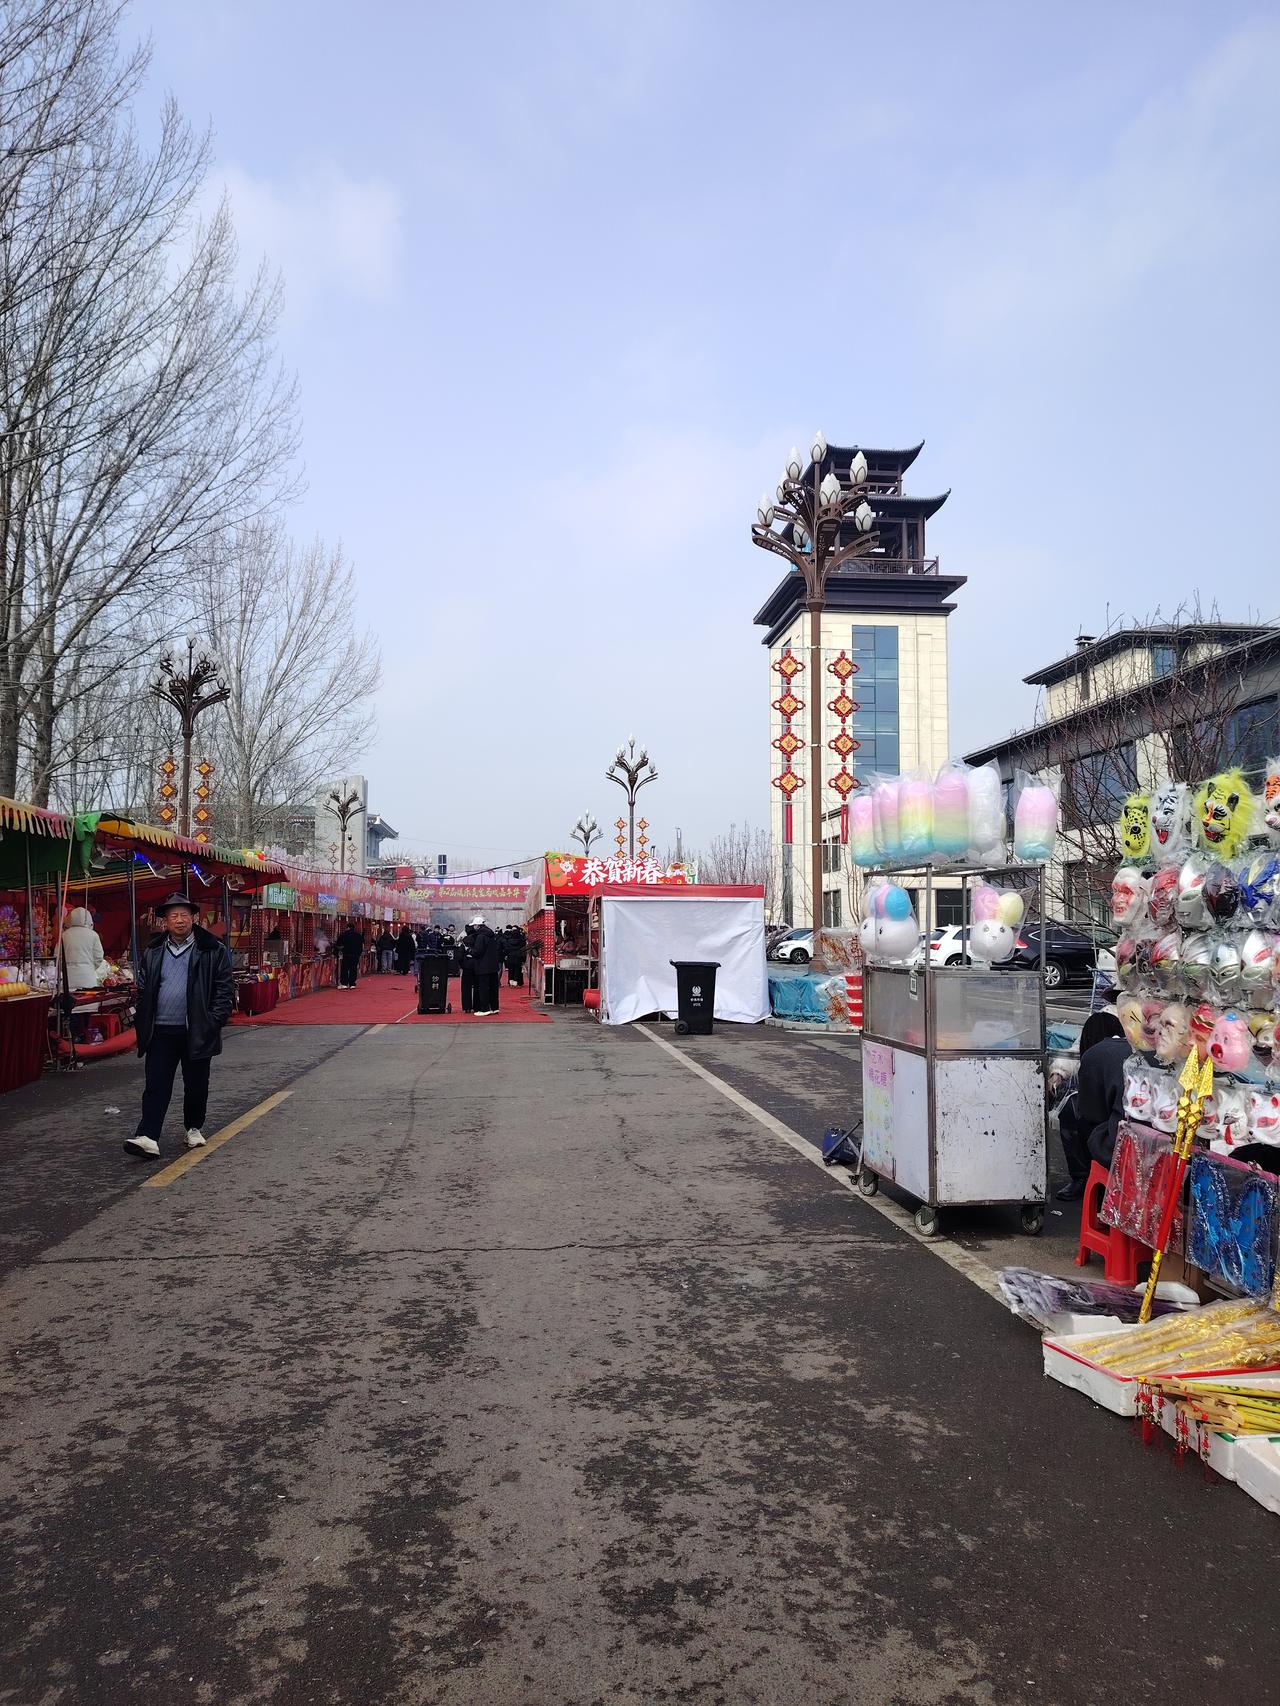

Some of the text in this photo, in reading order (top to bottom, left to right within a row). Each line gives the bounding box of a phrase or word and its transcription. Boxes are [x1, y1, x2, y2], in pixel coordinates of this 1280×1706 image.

[580, 857, 665, 886] 恭賀新春
[431, 975, 440, 990] 沙村
